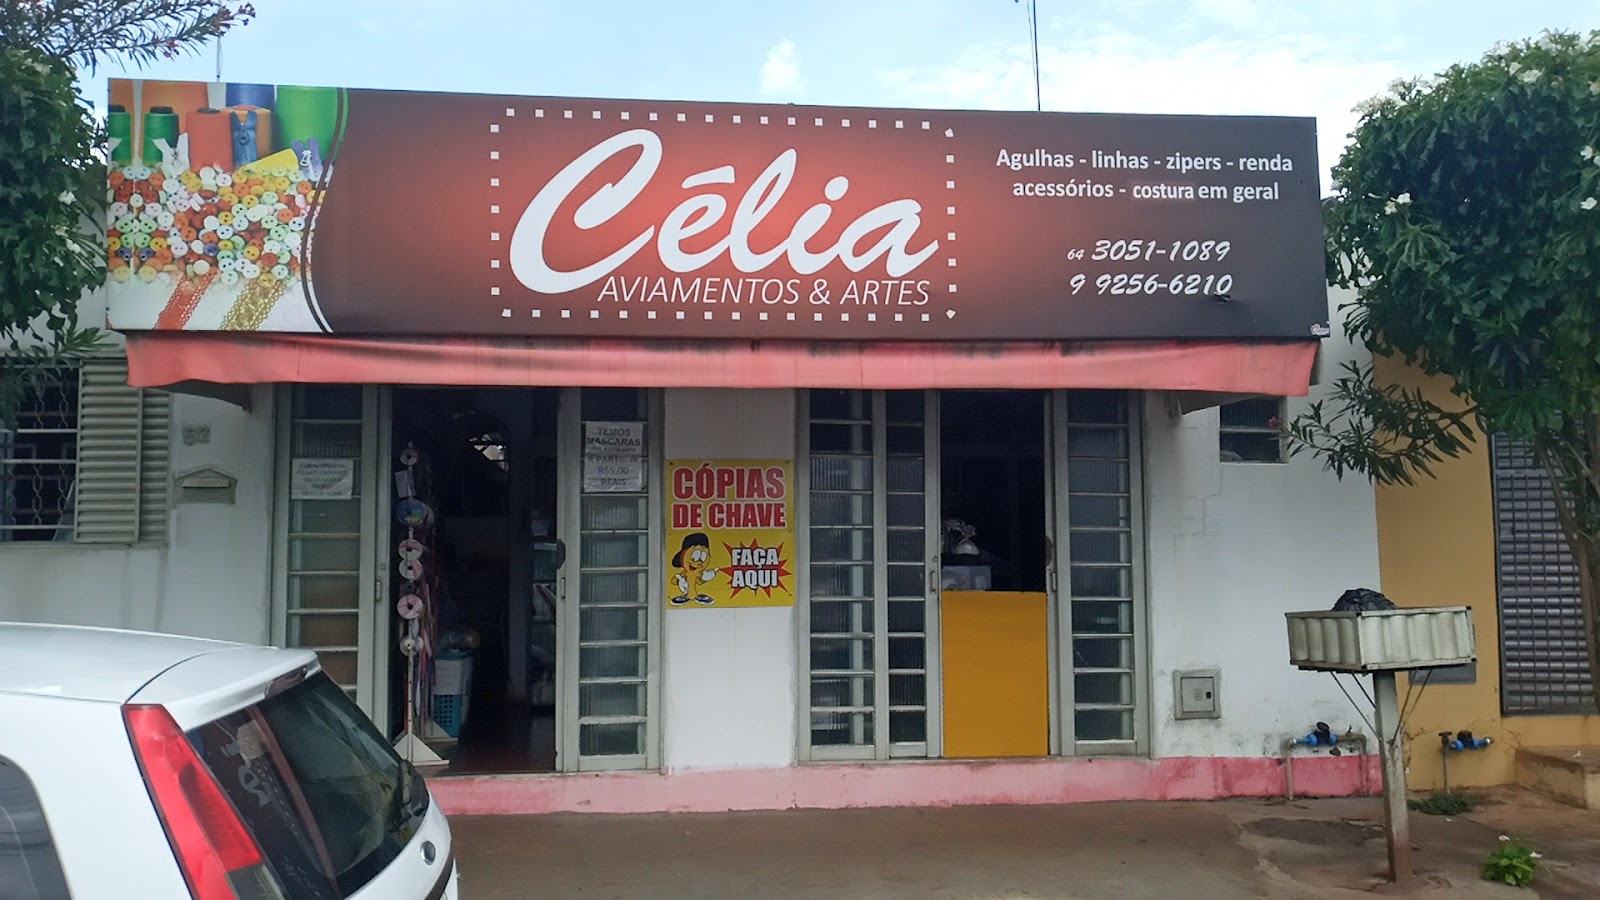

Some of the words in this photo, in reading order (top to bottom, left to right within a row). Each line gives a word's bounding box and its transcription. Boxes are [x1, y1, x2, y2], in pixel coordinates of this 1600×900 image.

[996, 149, 1074, 170] Agulhas
[1092, 150, 1149, 169] linhas
[1166, 152, 1222, 173] zipers
[1239, 154, 1293, 171] renda
[1013, 180, 1114, 197] acessórios
[1132, 183, 1194, 199] costura
[1198, 186, 1228, 199] em
[1232, 182, 1279, 203] geral
[510, 128, 940, 294] Célia
[1067, 249, 1085, 261] 64
[1091, 239, 1231, 262] 3051-1089
[597, 276, 800, 305] AVIAMENTOS
[808, 278, 831, 305] &
[839, 279, 931, 306] ARTES
[1069, 274, 1086, 295] 9
[1095, 274, 1233, 295] 9256-6210
[587, 437, 641, 446] MASCARAS
[598, 428, 631, 436] TEMOS
[674, 462, 785, 499] CÓPIAS
[672, 503, 703, 528] DE
[708, 503, 786, 528] CHAVE
[731, 548, 779, 569] FAÇA
[731, 569, 778, 590] AQUI
